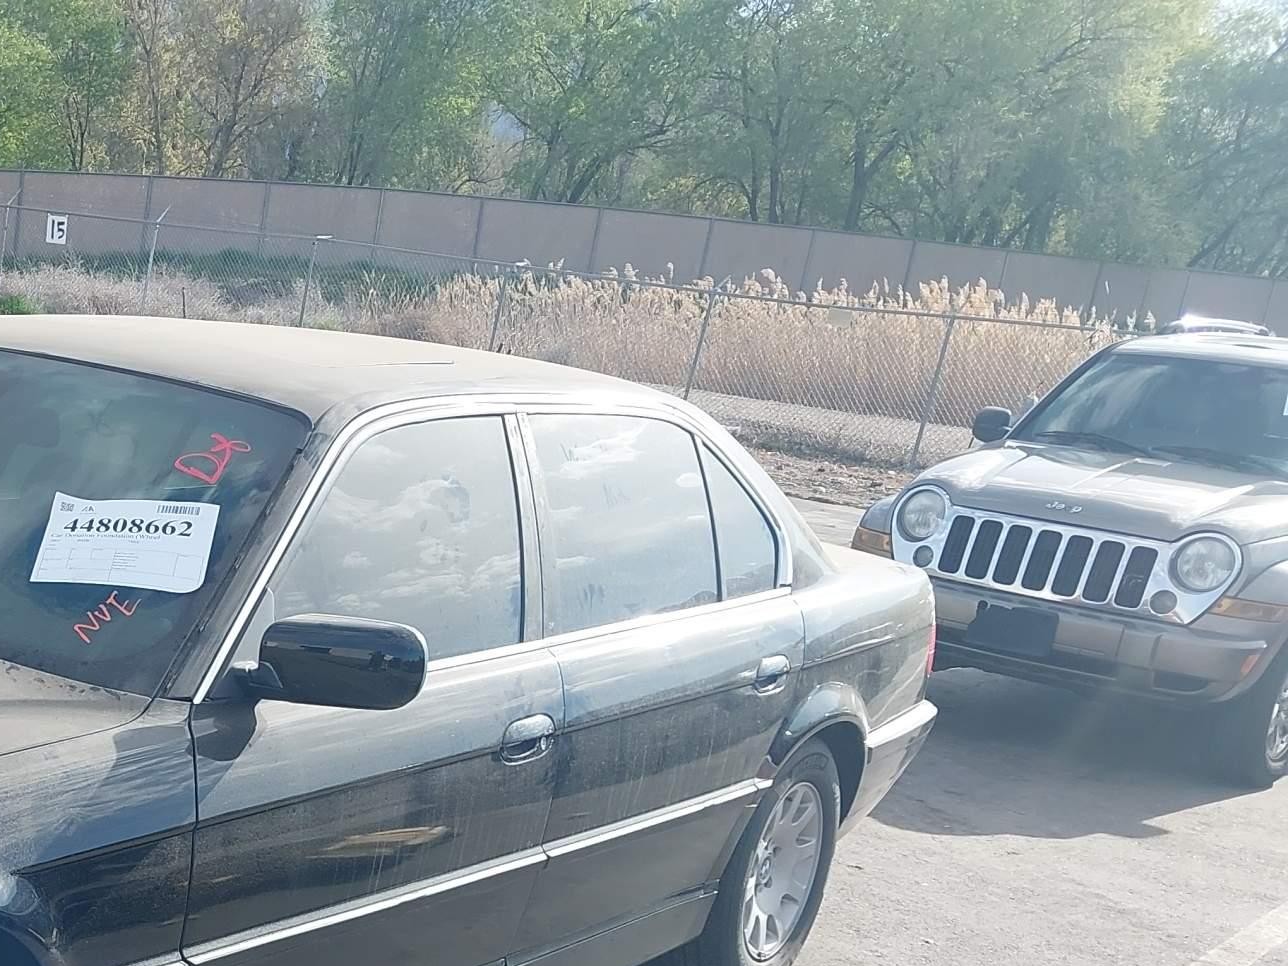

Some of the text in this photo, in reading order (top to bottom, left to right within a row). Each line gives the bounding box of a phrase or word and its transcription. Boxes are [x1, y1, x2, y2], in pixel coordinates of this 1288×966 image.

[51, 219, 65, 239] 15
[1045, 501, 1082, 513] Jep
[63, 517, 193, 537] 44808662
